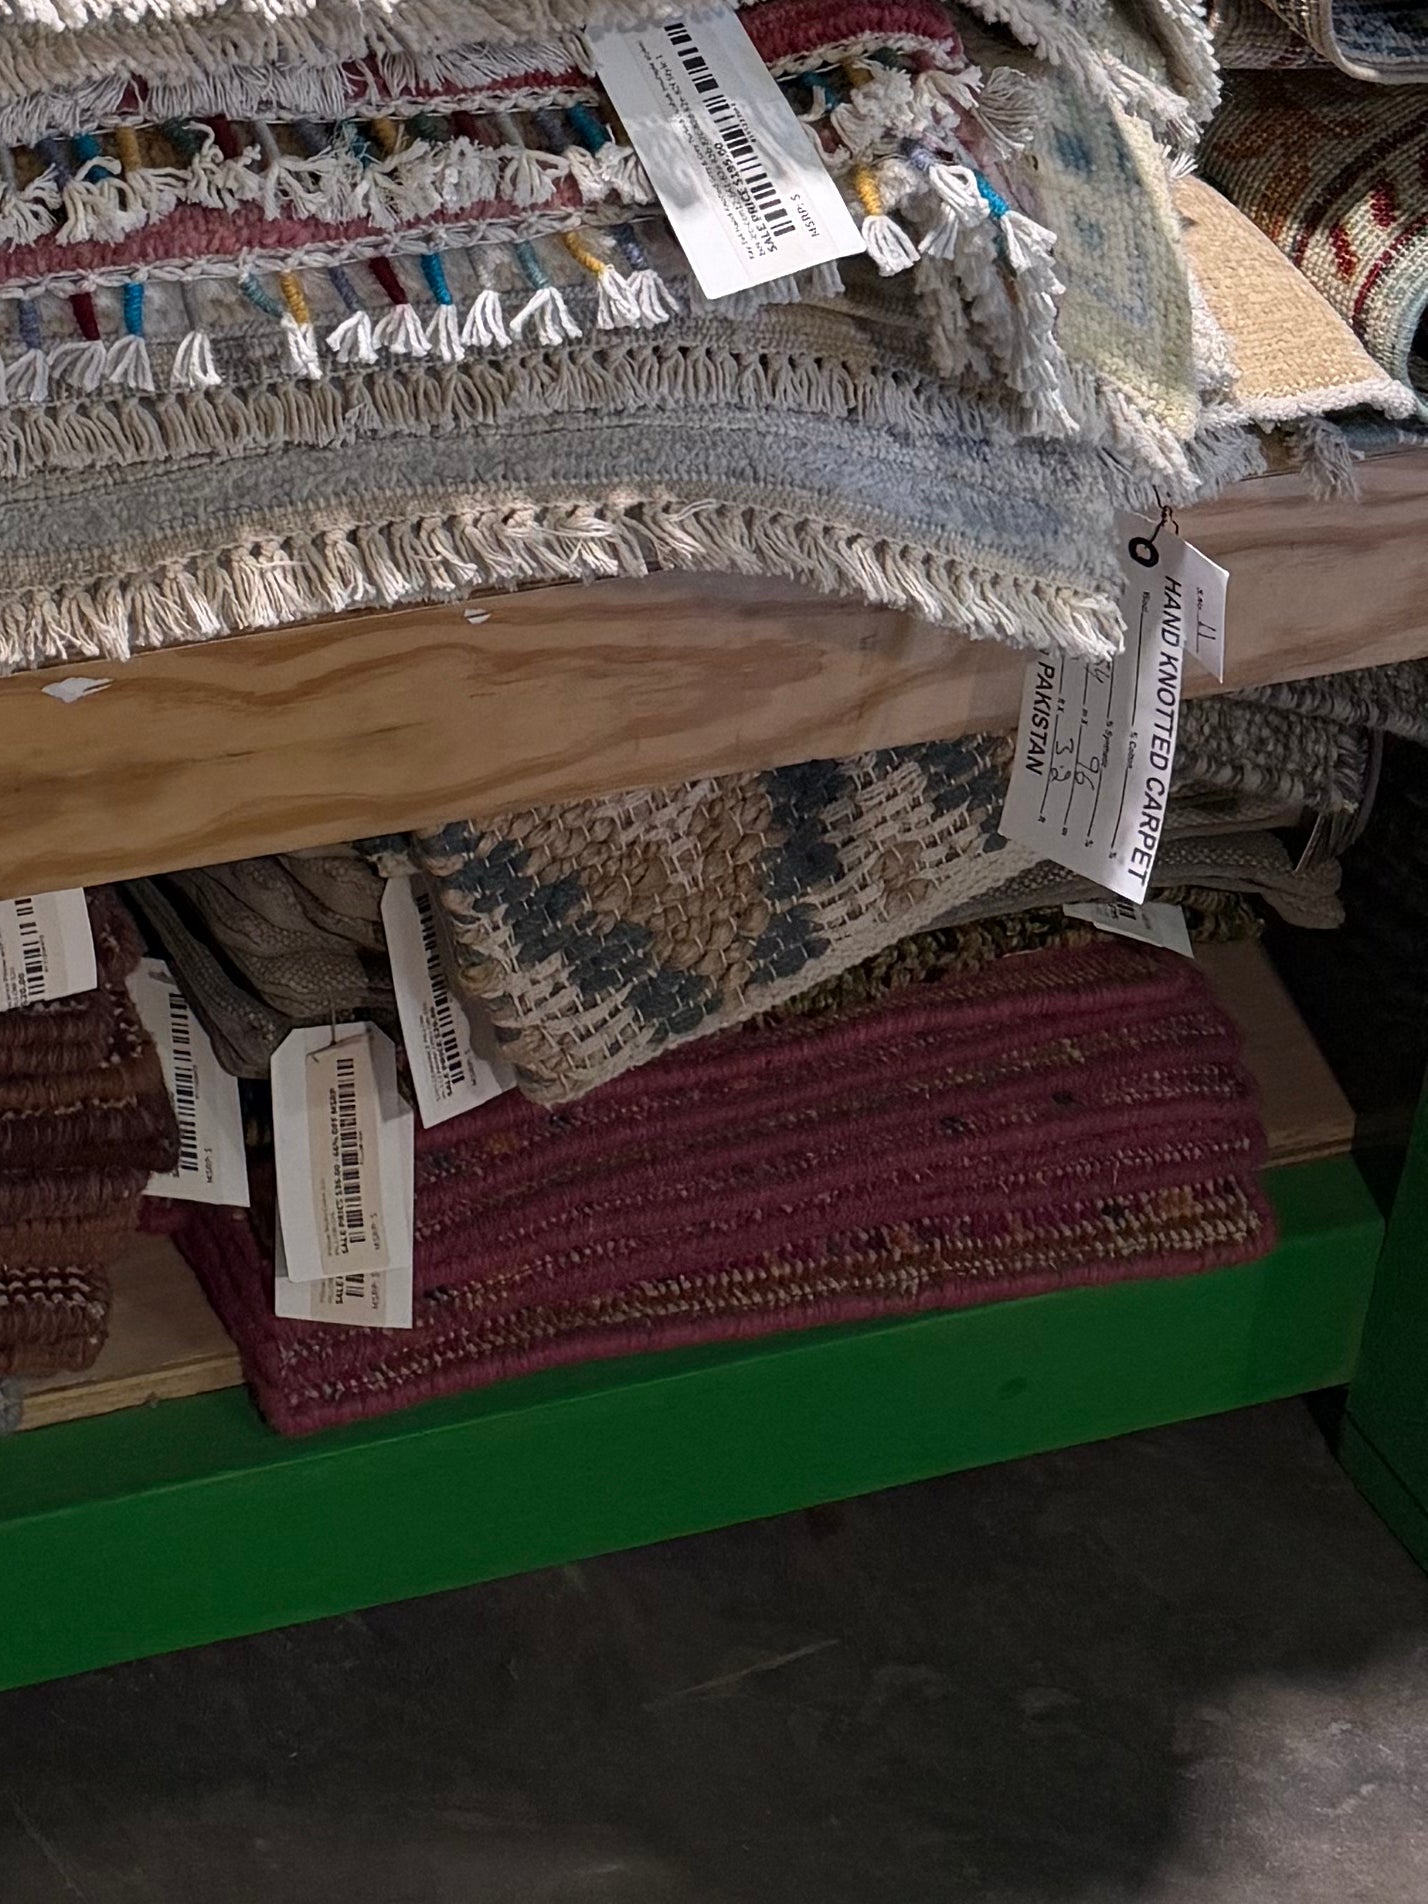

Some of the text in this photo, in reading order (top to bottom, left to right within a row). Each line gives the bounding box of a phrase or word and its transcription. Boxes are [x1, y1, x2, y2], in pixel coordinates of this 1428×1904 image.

[736, 185, 761, 222] PRICE
[756, 223, 777, 253] SALE
[1026, 661, 1056, 776] PAKISTAN
[1128, 575, 1183, 886] HAND KNOTTED CARPET
